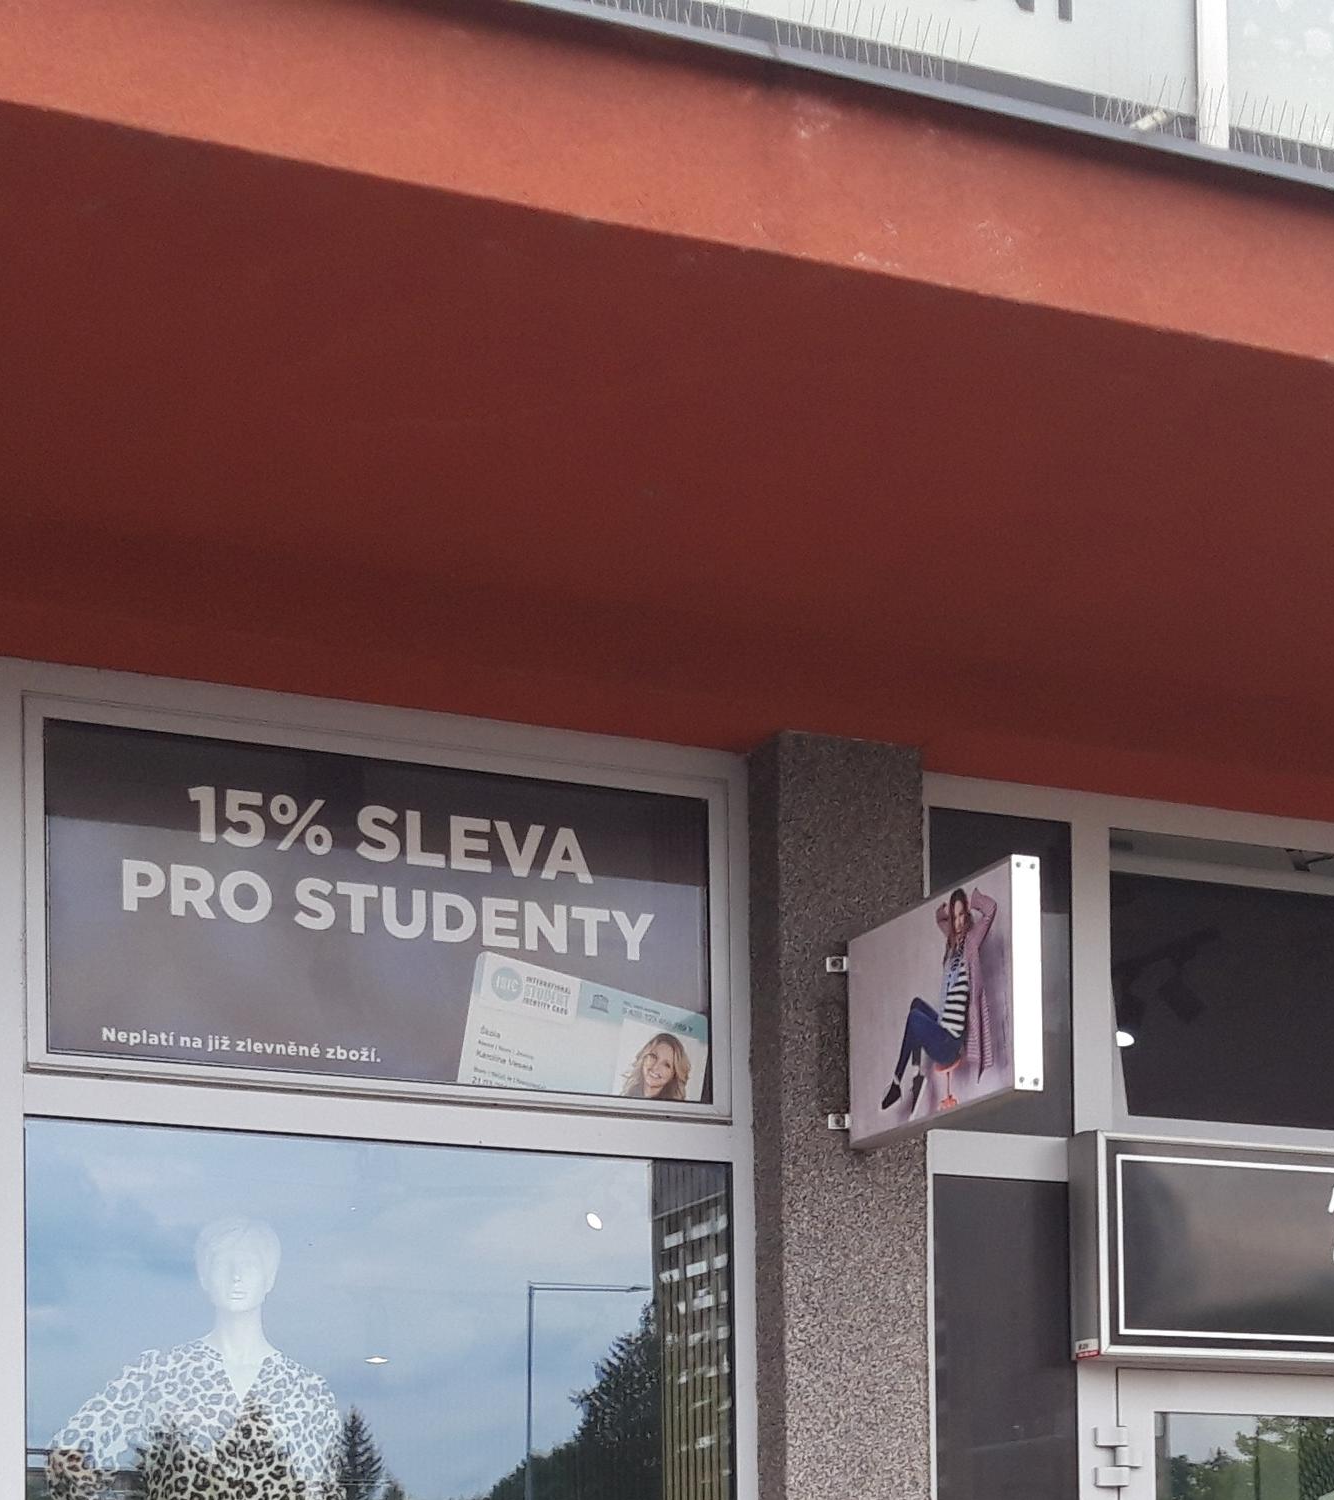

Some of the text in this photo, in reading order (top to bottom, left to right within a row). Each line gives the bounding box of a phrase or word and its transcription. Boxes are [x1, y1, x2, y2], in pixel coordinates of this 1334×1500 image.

[188, 785, 594, 884] 15% SLEVA
[121, 858, 655, 961] PRO STUDENTY
[101, 1025, 382, 1063] Neplatí na již zlevněné zboží.
